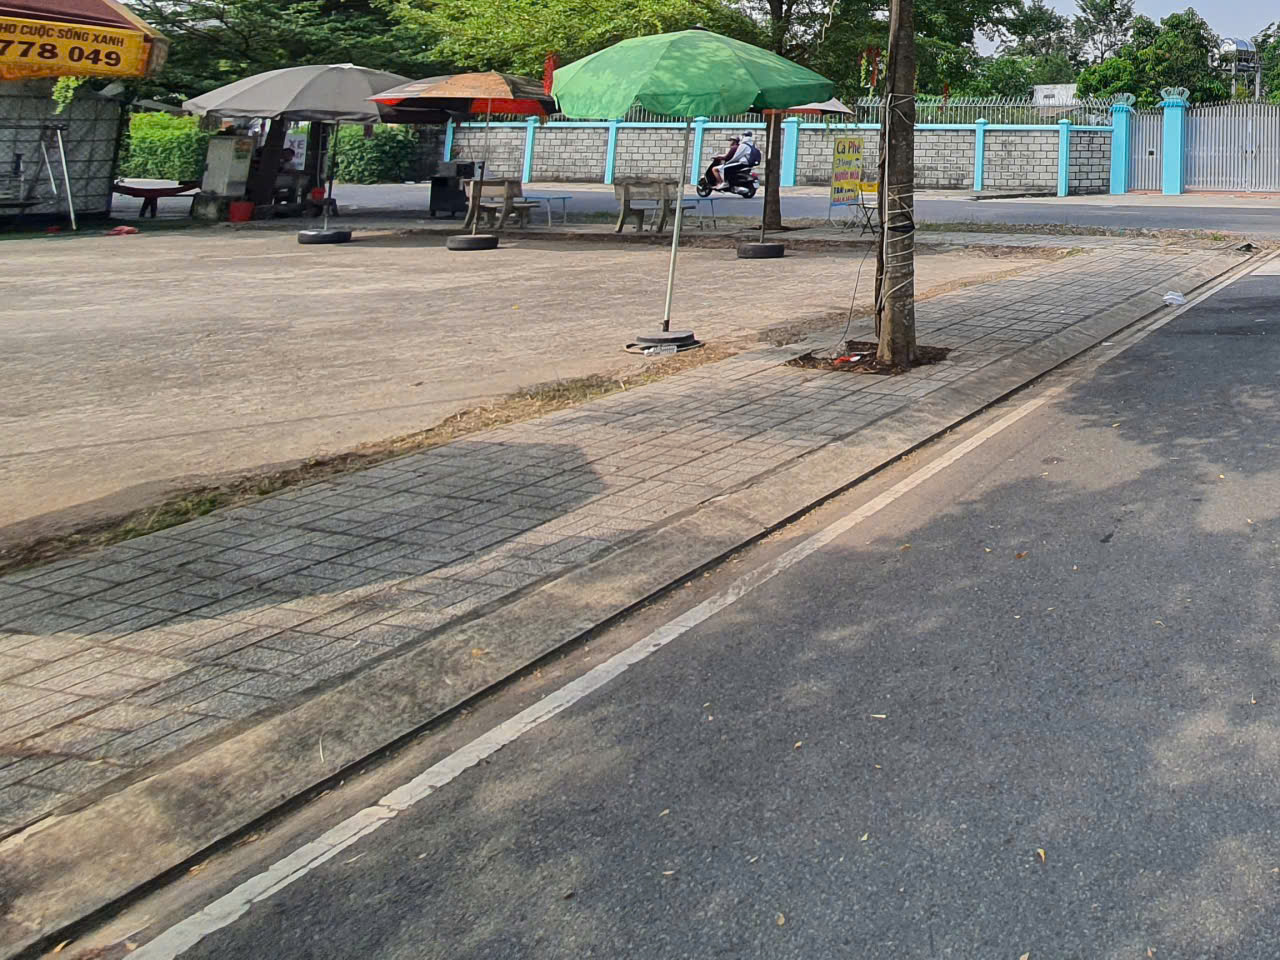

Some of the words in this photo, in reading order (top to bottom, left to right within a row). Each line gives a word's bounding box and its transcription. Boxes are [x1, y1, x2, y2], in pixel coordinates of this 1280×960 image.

[92, 33, 124, 47] XANH
[0, 39, 59, 60] 778
[68, 46, 121, 67] 049
[289, 139, 305, 149] XE
